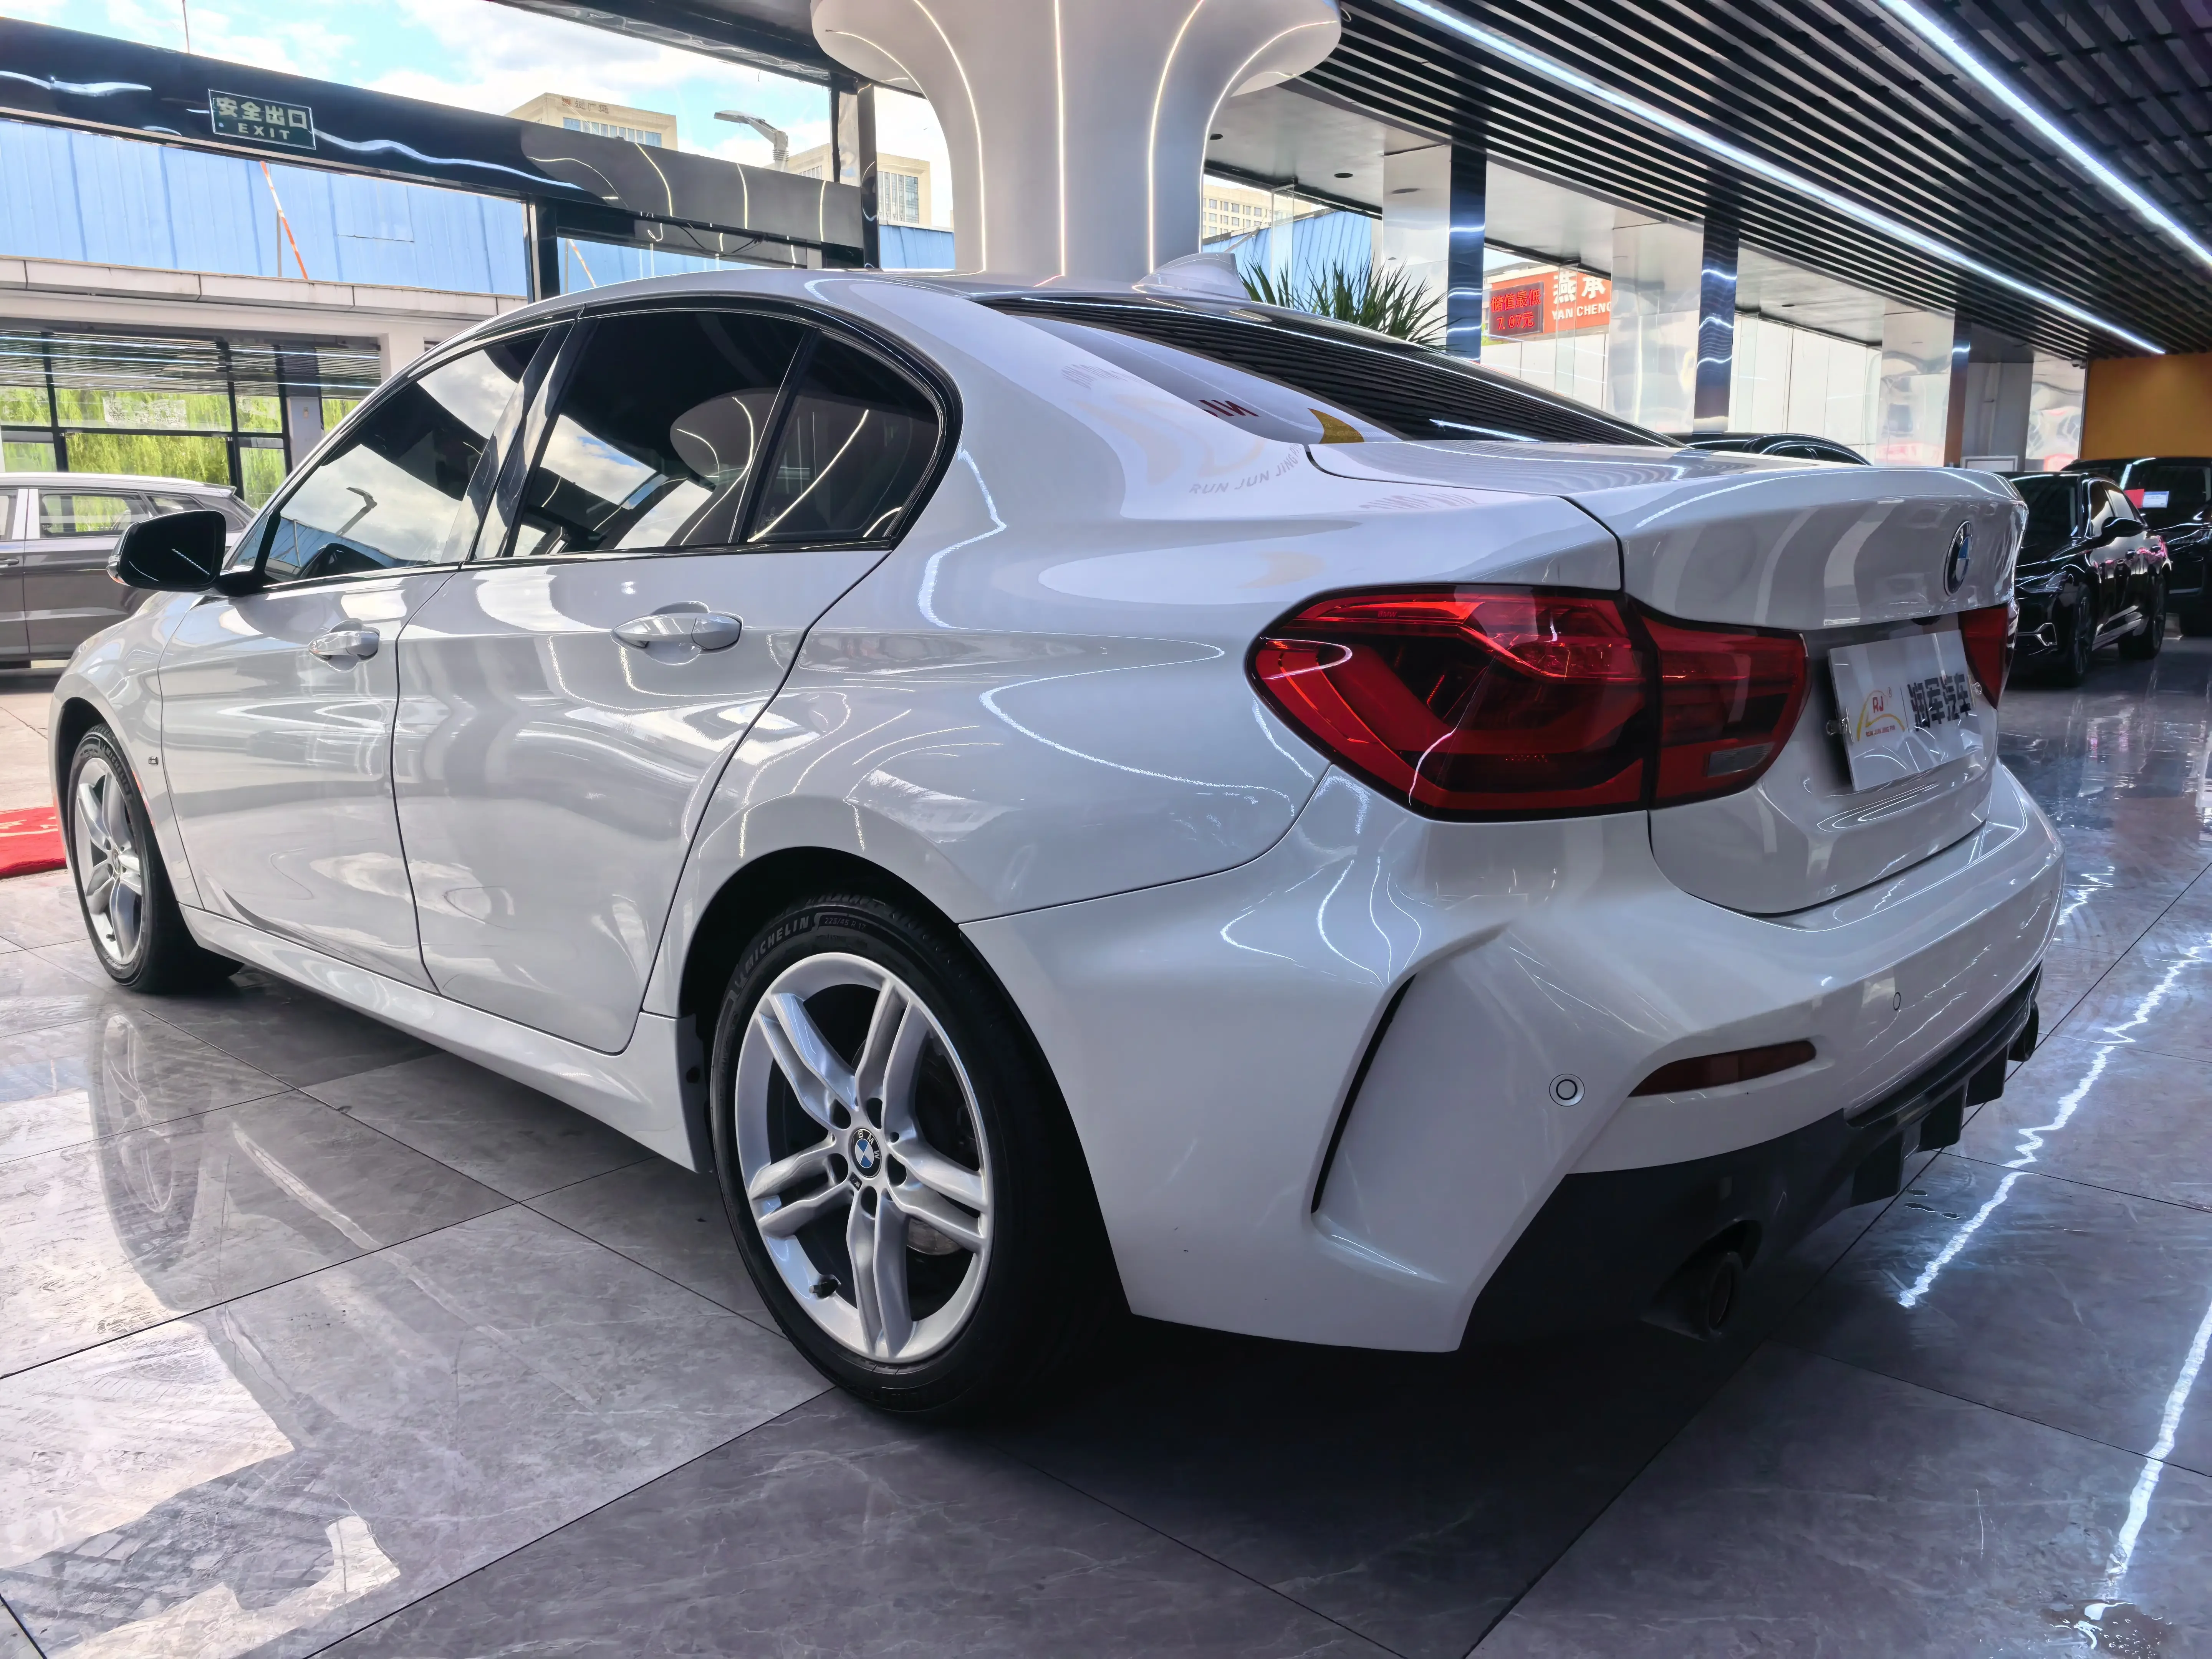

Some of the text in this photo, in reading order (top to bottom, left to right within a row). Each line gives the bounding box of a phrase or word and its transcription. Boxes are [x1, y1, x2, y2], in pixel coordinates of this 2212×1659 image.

[216, 97, 307, 129] 安全出口
[238, 123, 290, 140] EXIT
[1491, 289, 1541, 313] 储值最低
[1551, 308, 1573, 320] YAN
[745, 916, 810, 972] MICHELIN
[858, 1130, 880, 1159] BMW
